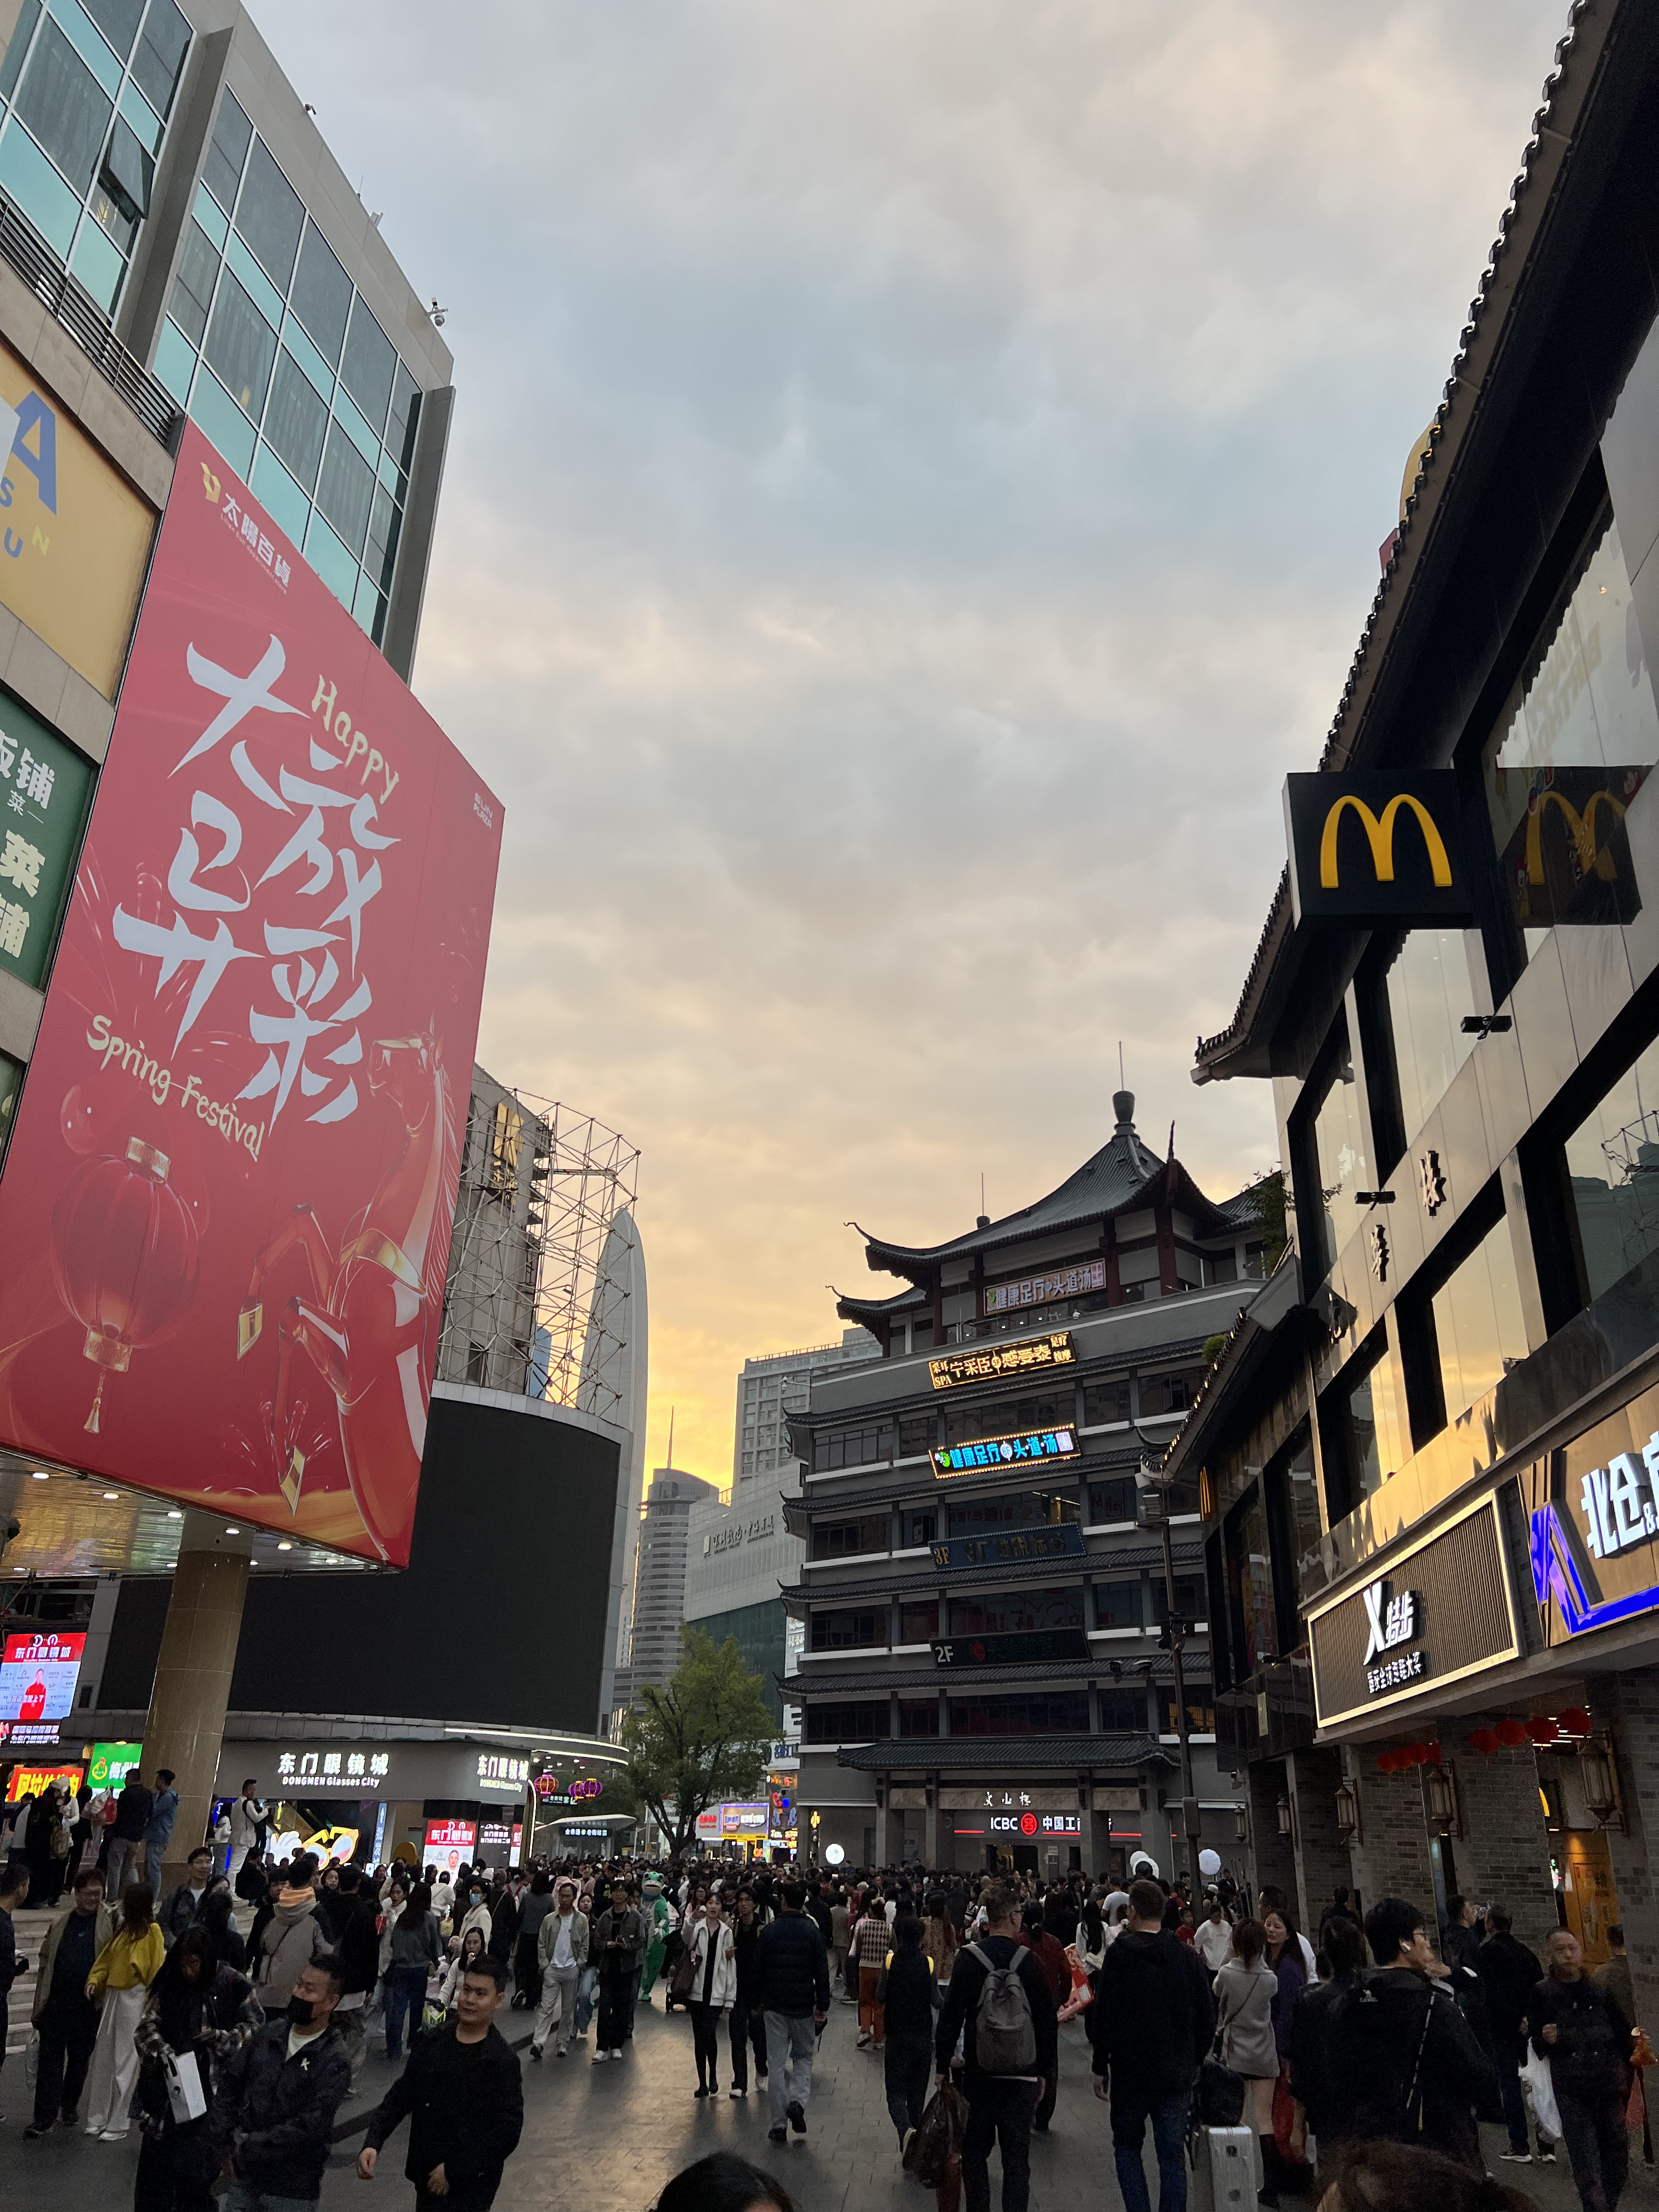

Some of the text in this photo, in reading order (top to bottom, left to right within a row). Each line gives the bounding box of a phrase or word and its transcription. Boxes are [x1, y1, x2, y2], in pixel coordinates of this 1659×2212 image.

[222, 492, 291, 588] 太陽百貨
[311, 674, 400, 805] Happy
[473, 802, 492, 830] PLAZA
[474, 792, 493, 819] SUN
[86, 1014, 266, 1163] Spring Festival
[996, 1278, 1046, 1310] 健康足疗
[950, 1356, 994, 1378] 宁采臣
[934, 1374, 952, 1386] SPA
[949, 1443, 1000, 1469] 健康足疗
[1002, 1446, 1011, 1455] 6F
[933, 1547, 950, 1566] 3F
[935, 1646, 954, 1663] 2F
[278, 1752, 390, 1776] 东门眼镜城
[282, 1776, 381, 1788] DONGMEN Glasses City
[990, 1817, 1018, 1830] ICBC
